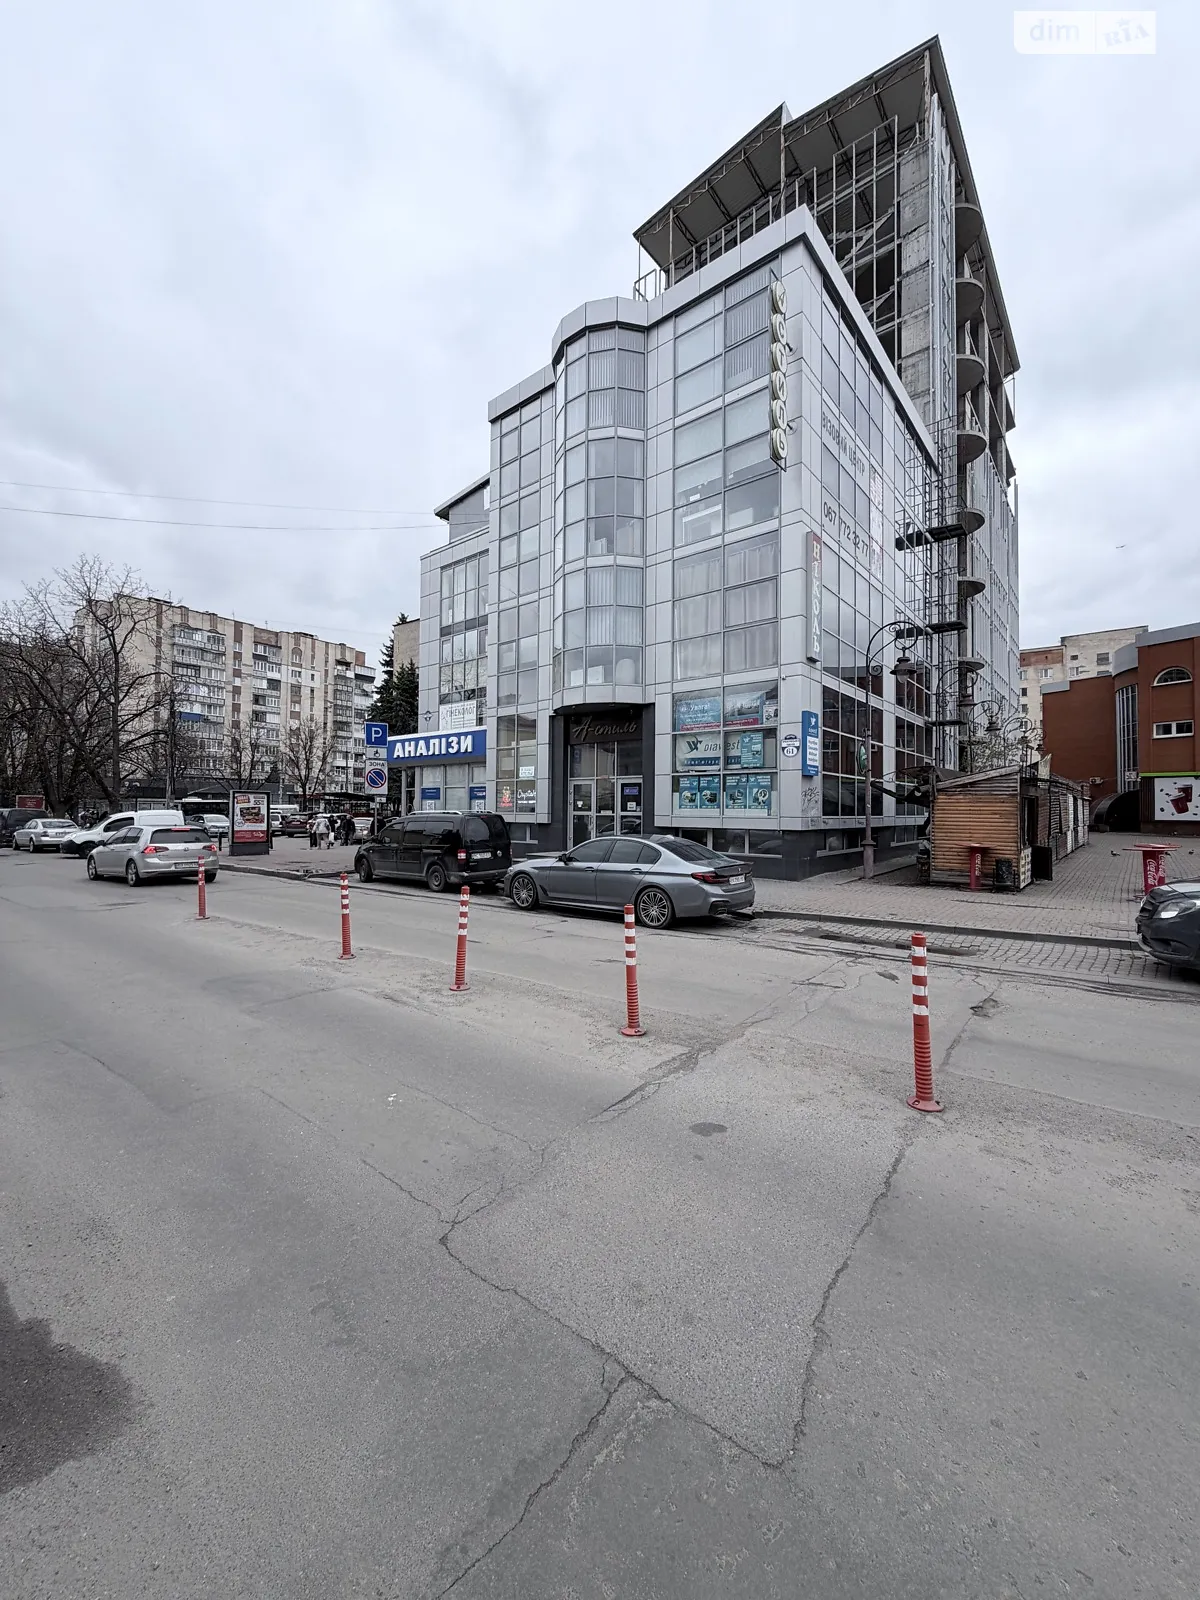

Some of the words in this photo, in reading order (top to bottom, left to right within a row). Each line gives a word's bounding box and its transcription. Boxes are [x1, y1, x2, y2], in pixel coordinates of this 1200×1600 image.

[823, 501, 837, 526] 067
[851, 530, 861, 551] 32
[861, 538, 869, 557] 77
[371, 728, 382, 742] P
[393, 735, 473, 758] АНАЛІЗИ
